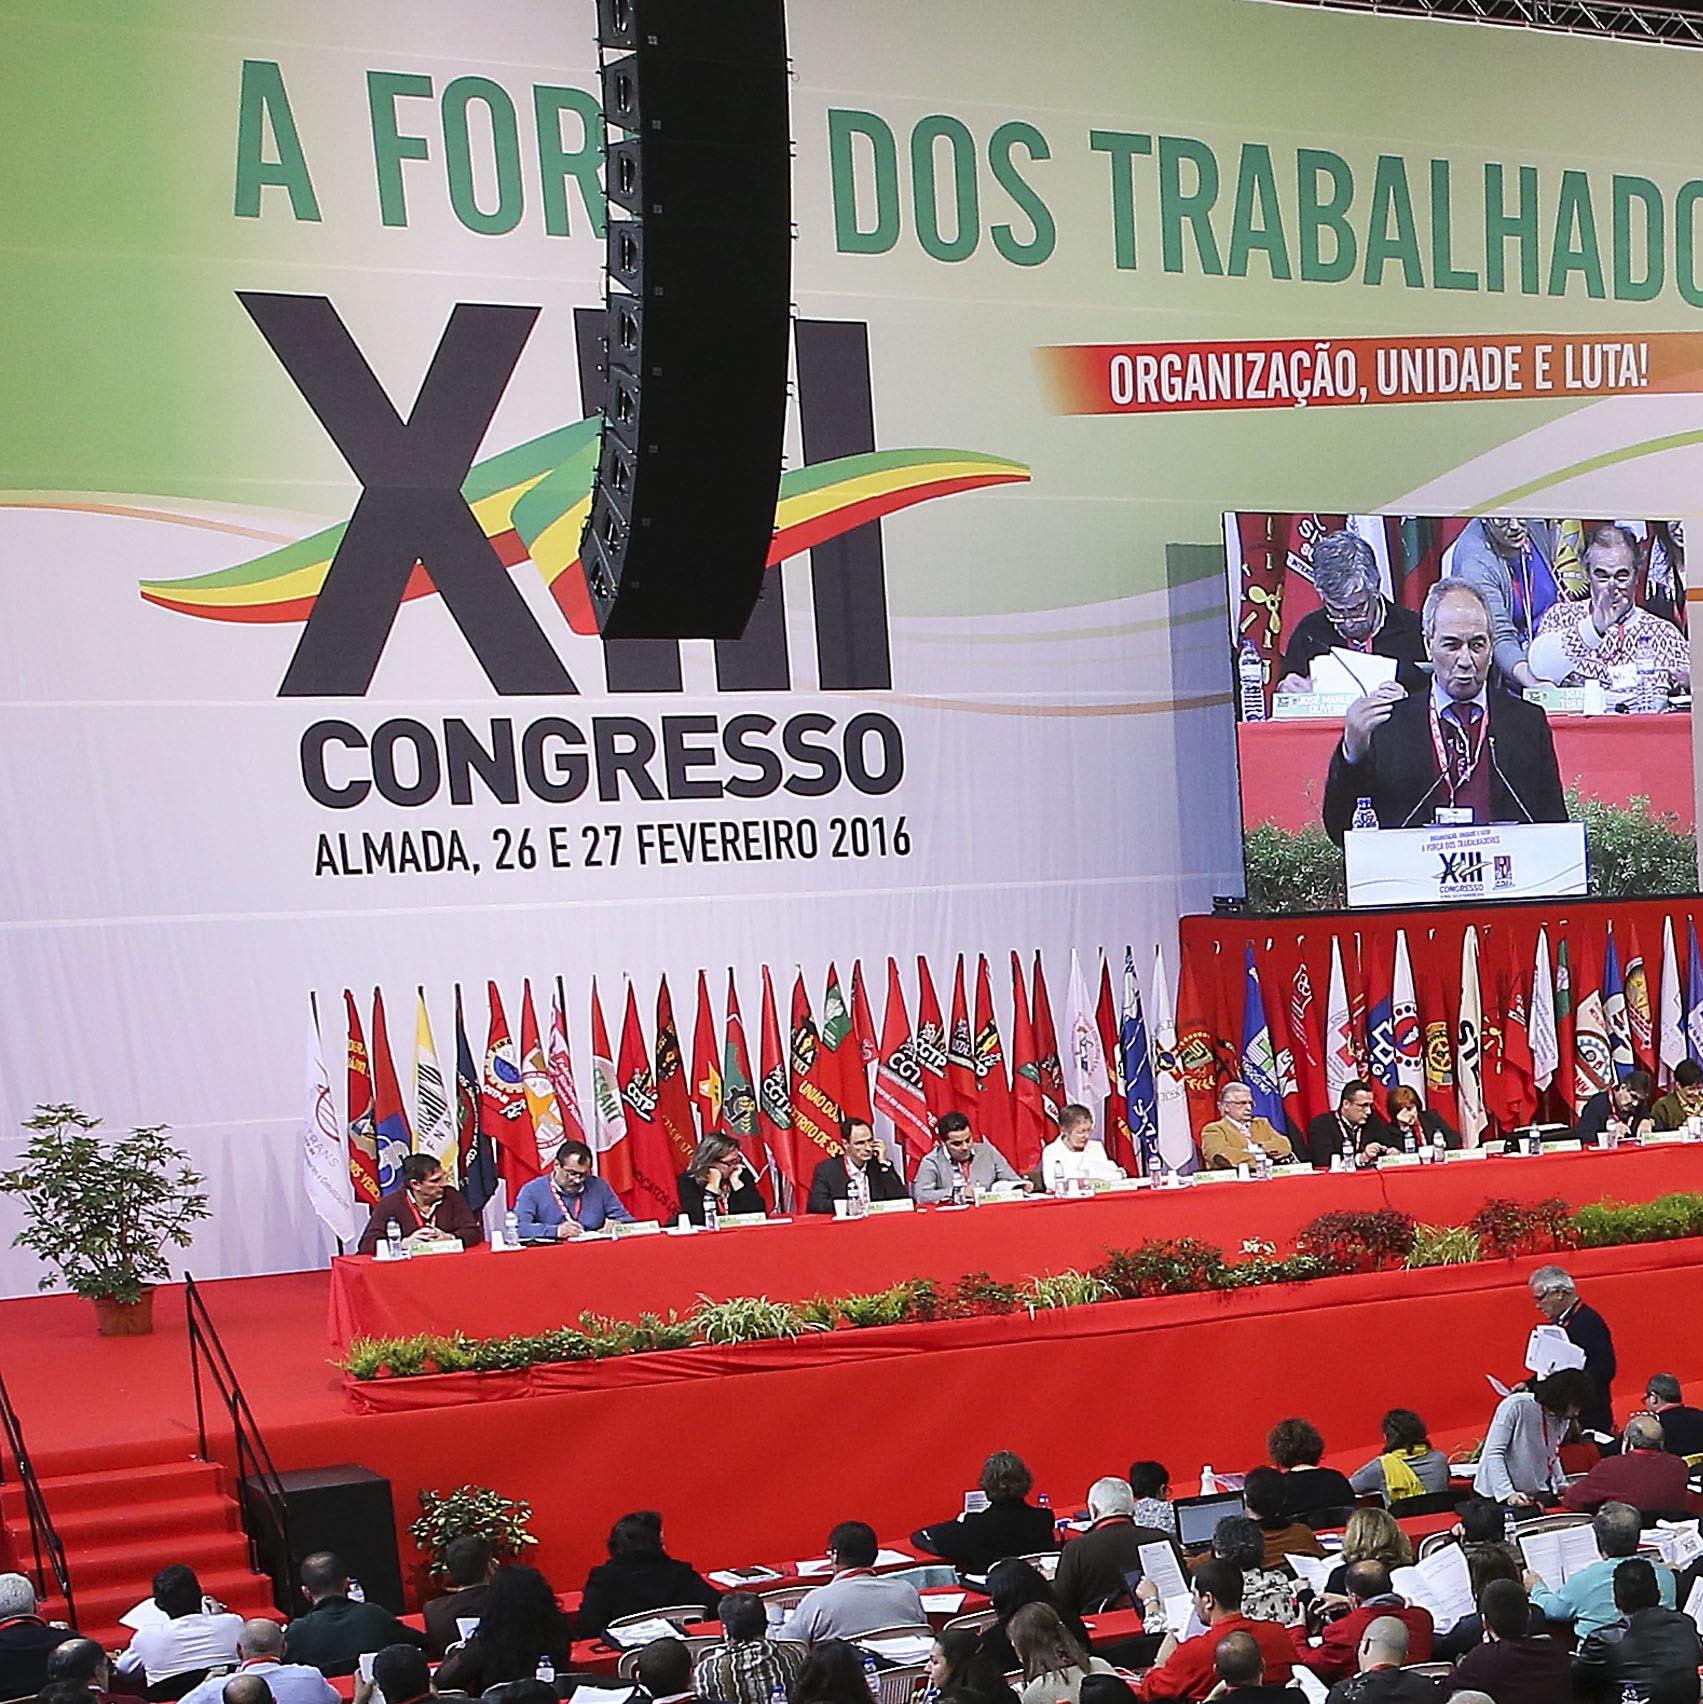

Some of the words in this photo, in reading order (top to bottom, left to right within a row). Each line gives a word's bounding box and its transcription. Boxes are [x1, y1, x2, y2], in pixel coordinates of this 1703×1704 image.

[233, 59, 322, 222] A
[366, 70, 610, 239] FOR
[828, 108, 1056, 266] DOS
[1110, 342, 1368, 407] ORGANIZAÇÃO,
[1376, 345, 1522, 395] UNIDADE
[1534, 345, 1553, 389] E
[1564, 343, 1648, 389] LUTA!
[299, 712, 905, 809] CONGRESSO
[314, 830, 481, 877] ALMADA,
[495, 827, 537, 870] 26
[551, 826, 569, 867] E
[581, 825, 622, 867] 27
[637, 818, 818, 865] FEVEREIRO
[830, 815, 912, 858] 2016
[889, 1052, 923, 1088] CGT
